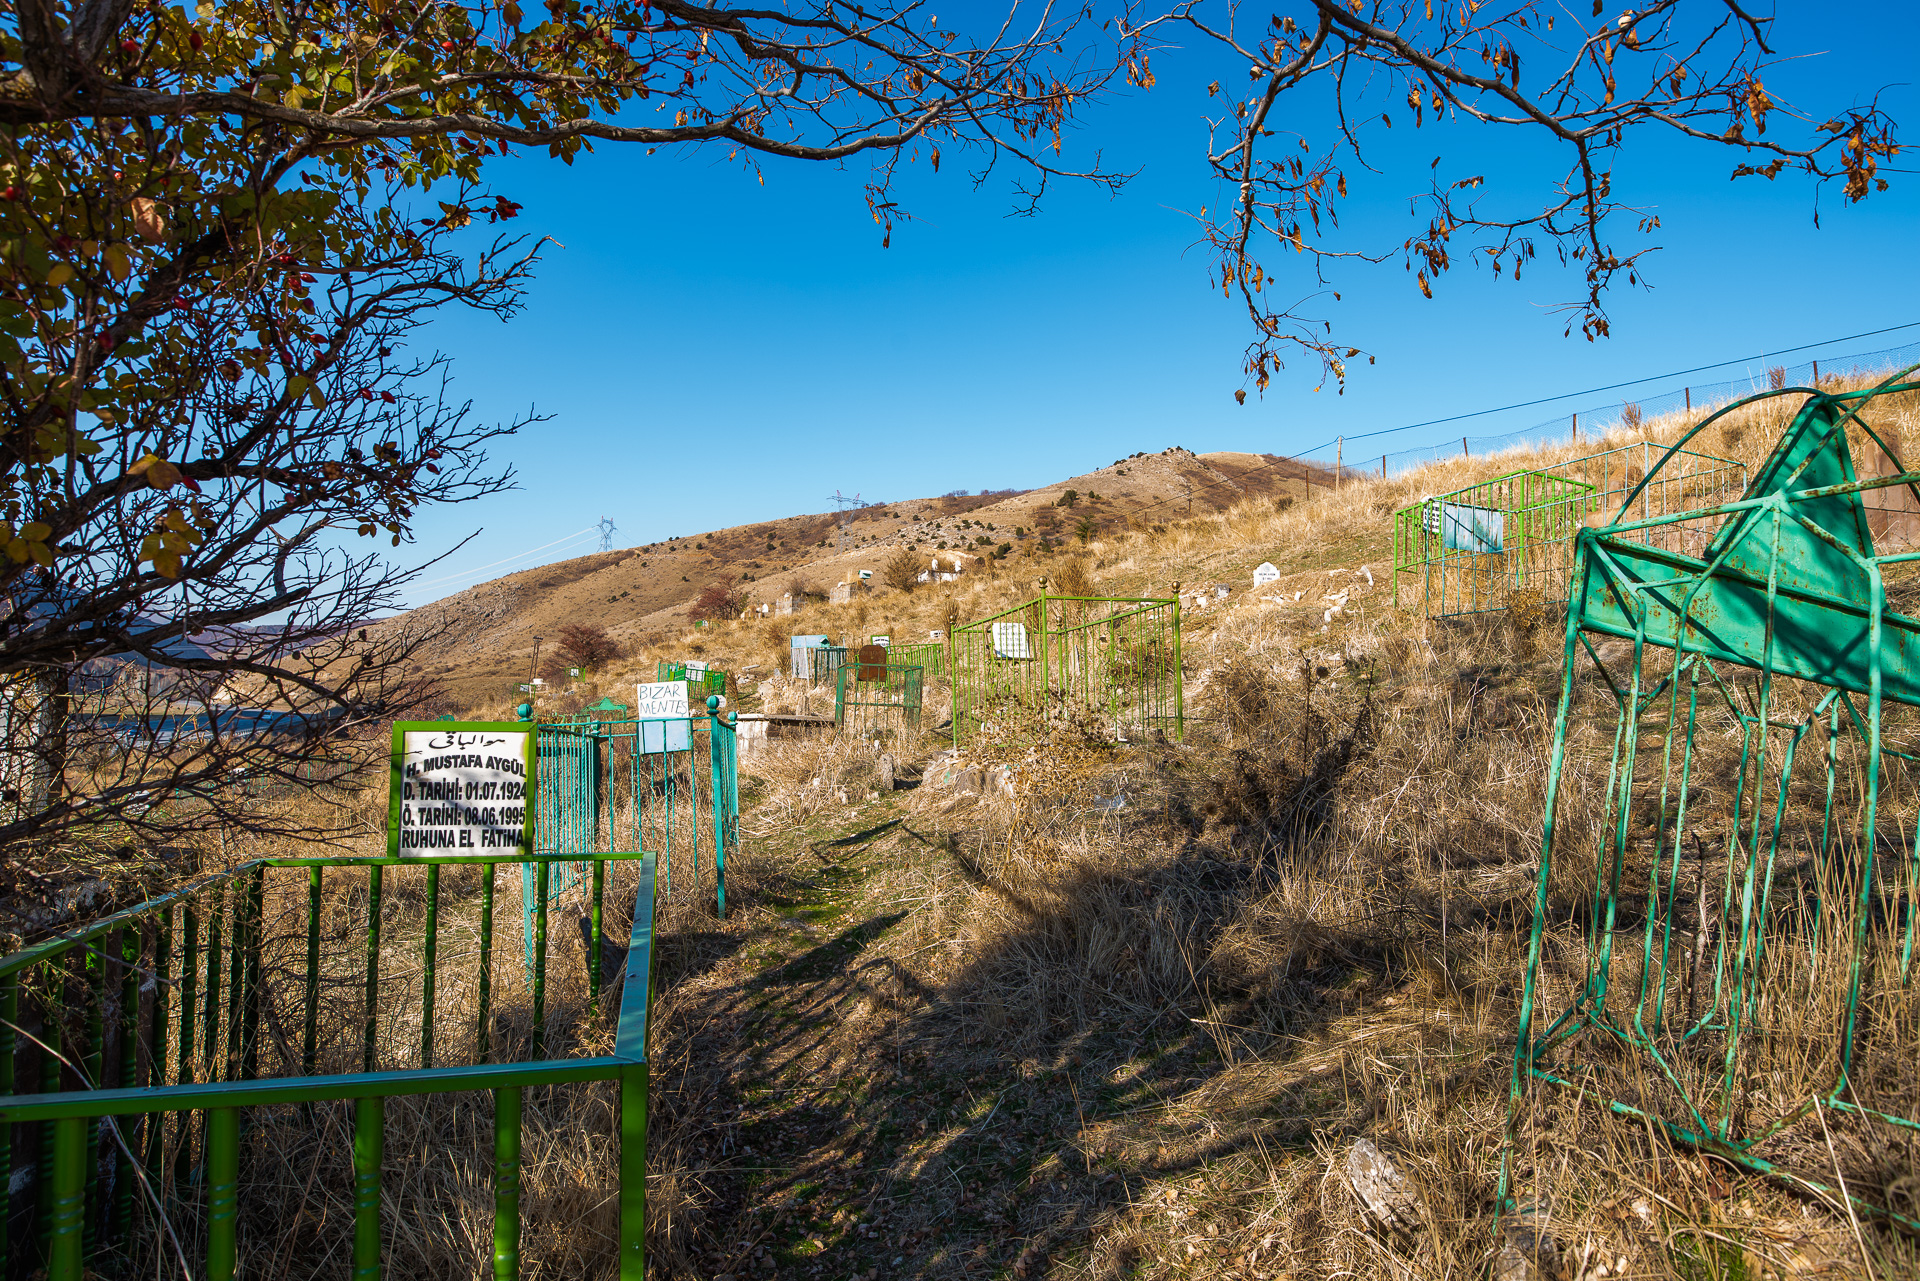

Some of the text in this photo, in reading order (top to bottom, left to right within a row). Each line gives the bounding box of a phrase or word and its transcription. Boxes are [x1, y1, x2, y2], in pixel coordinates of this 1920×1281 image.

[640, 684, 680, 700] BIZAR
[640, 700, 687, 717] MENTEŞ
[407, 755, 526, 777] H. MUSTAFA AYGÜL
[404, 778, 526, 800] D. TARİHİ: 01.07.1924
[403, 803, 525, 826] Ö. TARİHİ: 08.06.1995
[402, 830, 455, 848] RUHUNA
[459, 830, 474, 847] EL
